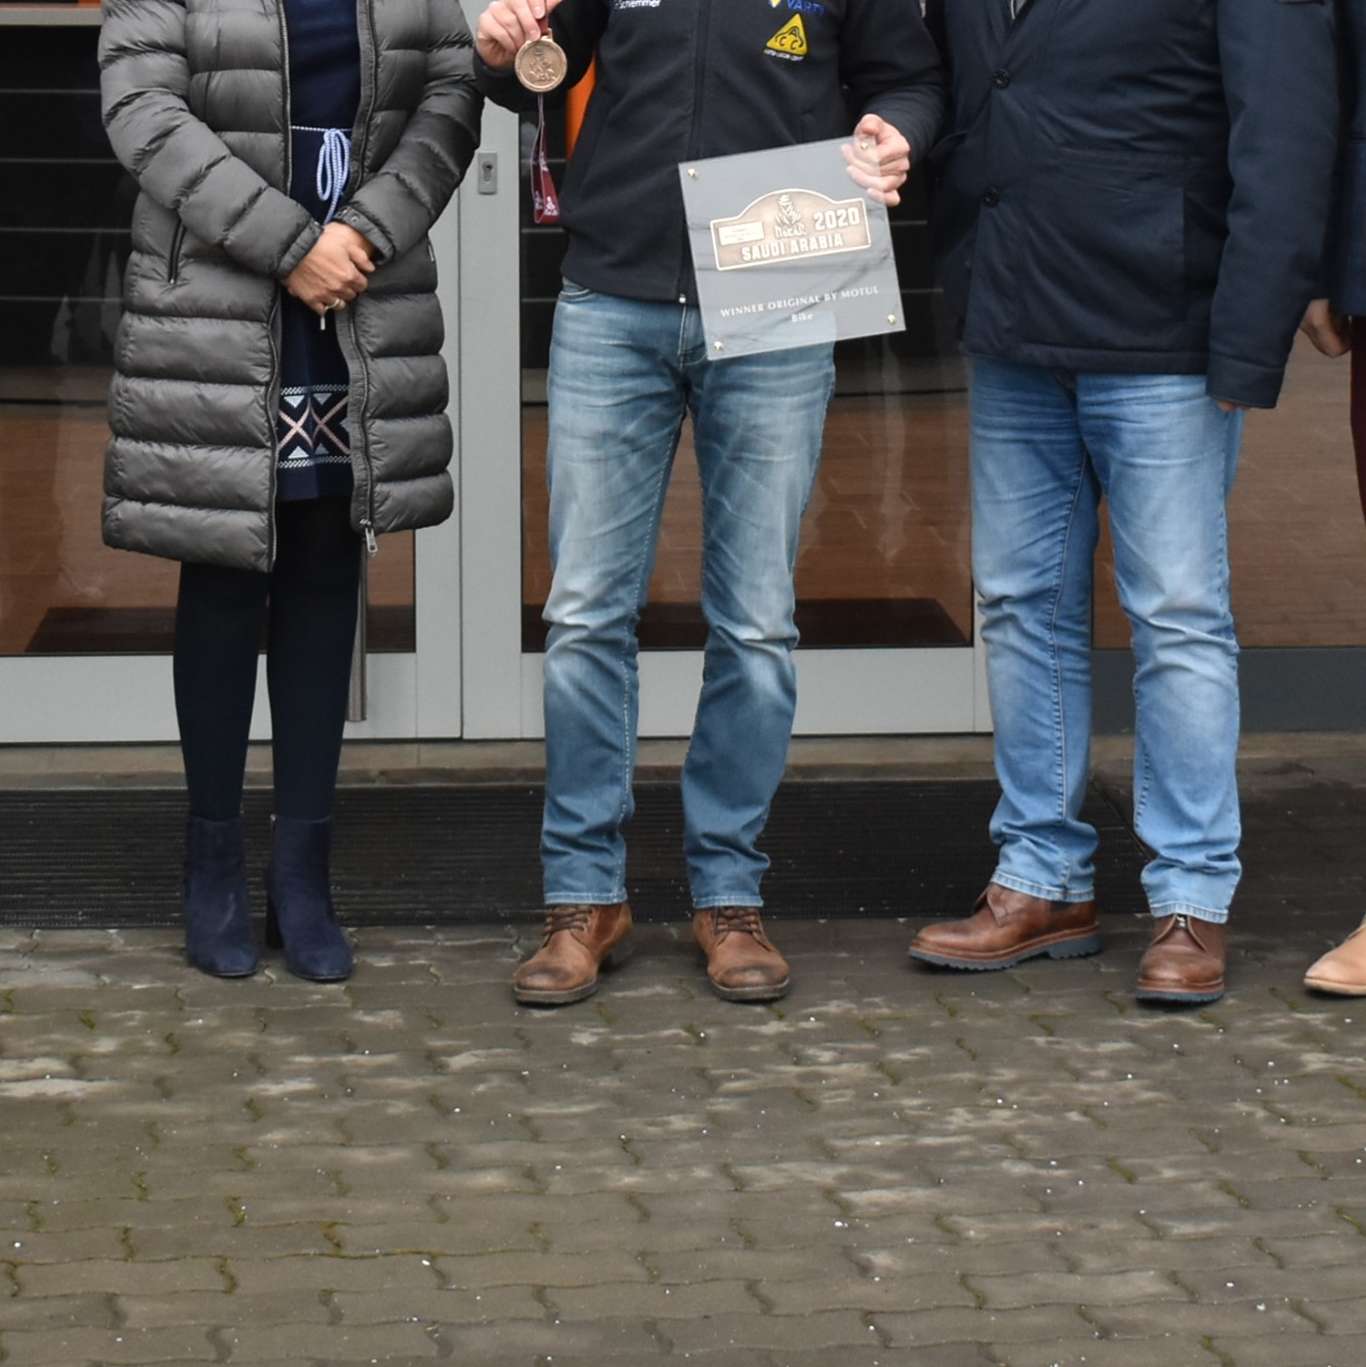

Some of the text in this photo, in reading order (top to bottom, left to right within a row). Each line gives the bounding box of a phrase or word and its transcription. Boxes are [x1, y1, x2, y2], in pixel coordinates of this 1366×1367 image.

[813, 207, 861, 232] 2020
[741, 234, 844, 262] SAUDI ARABIA
[720, 302, 764, 318] WINNER
[767, 296, 821, 311] ORIGINAL
[840, 286, 880, 299] MOTUL
[791, 311, 814, 323] Bike
